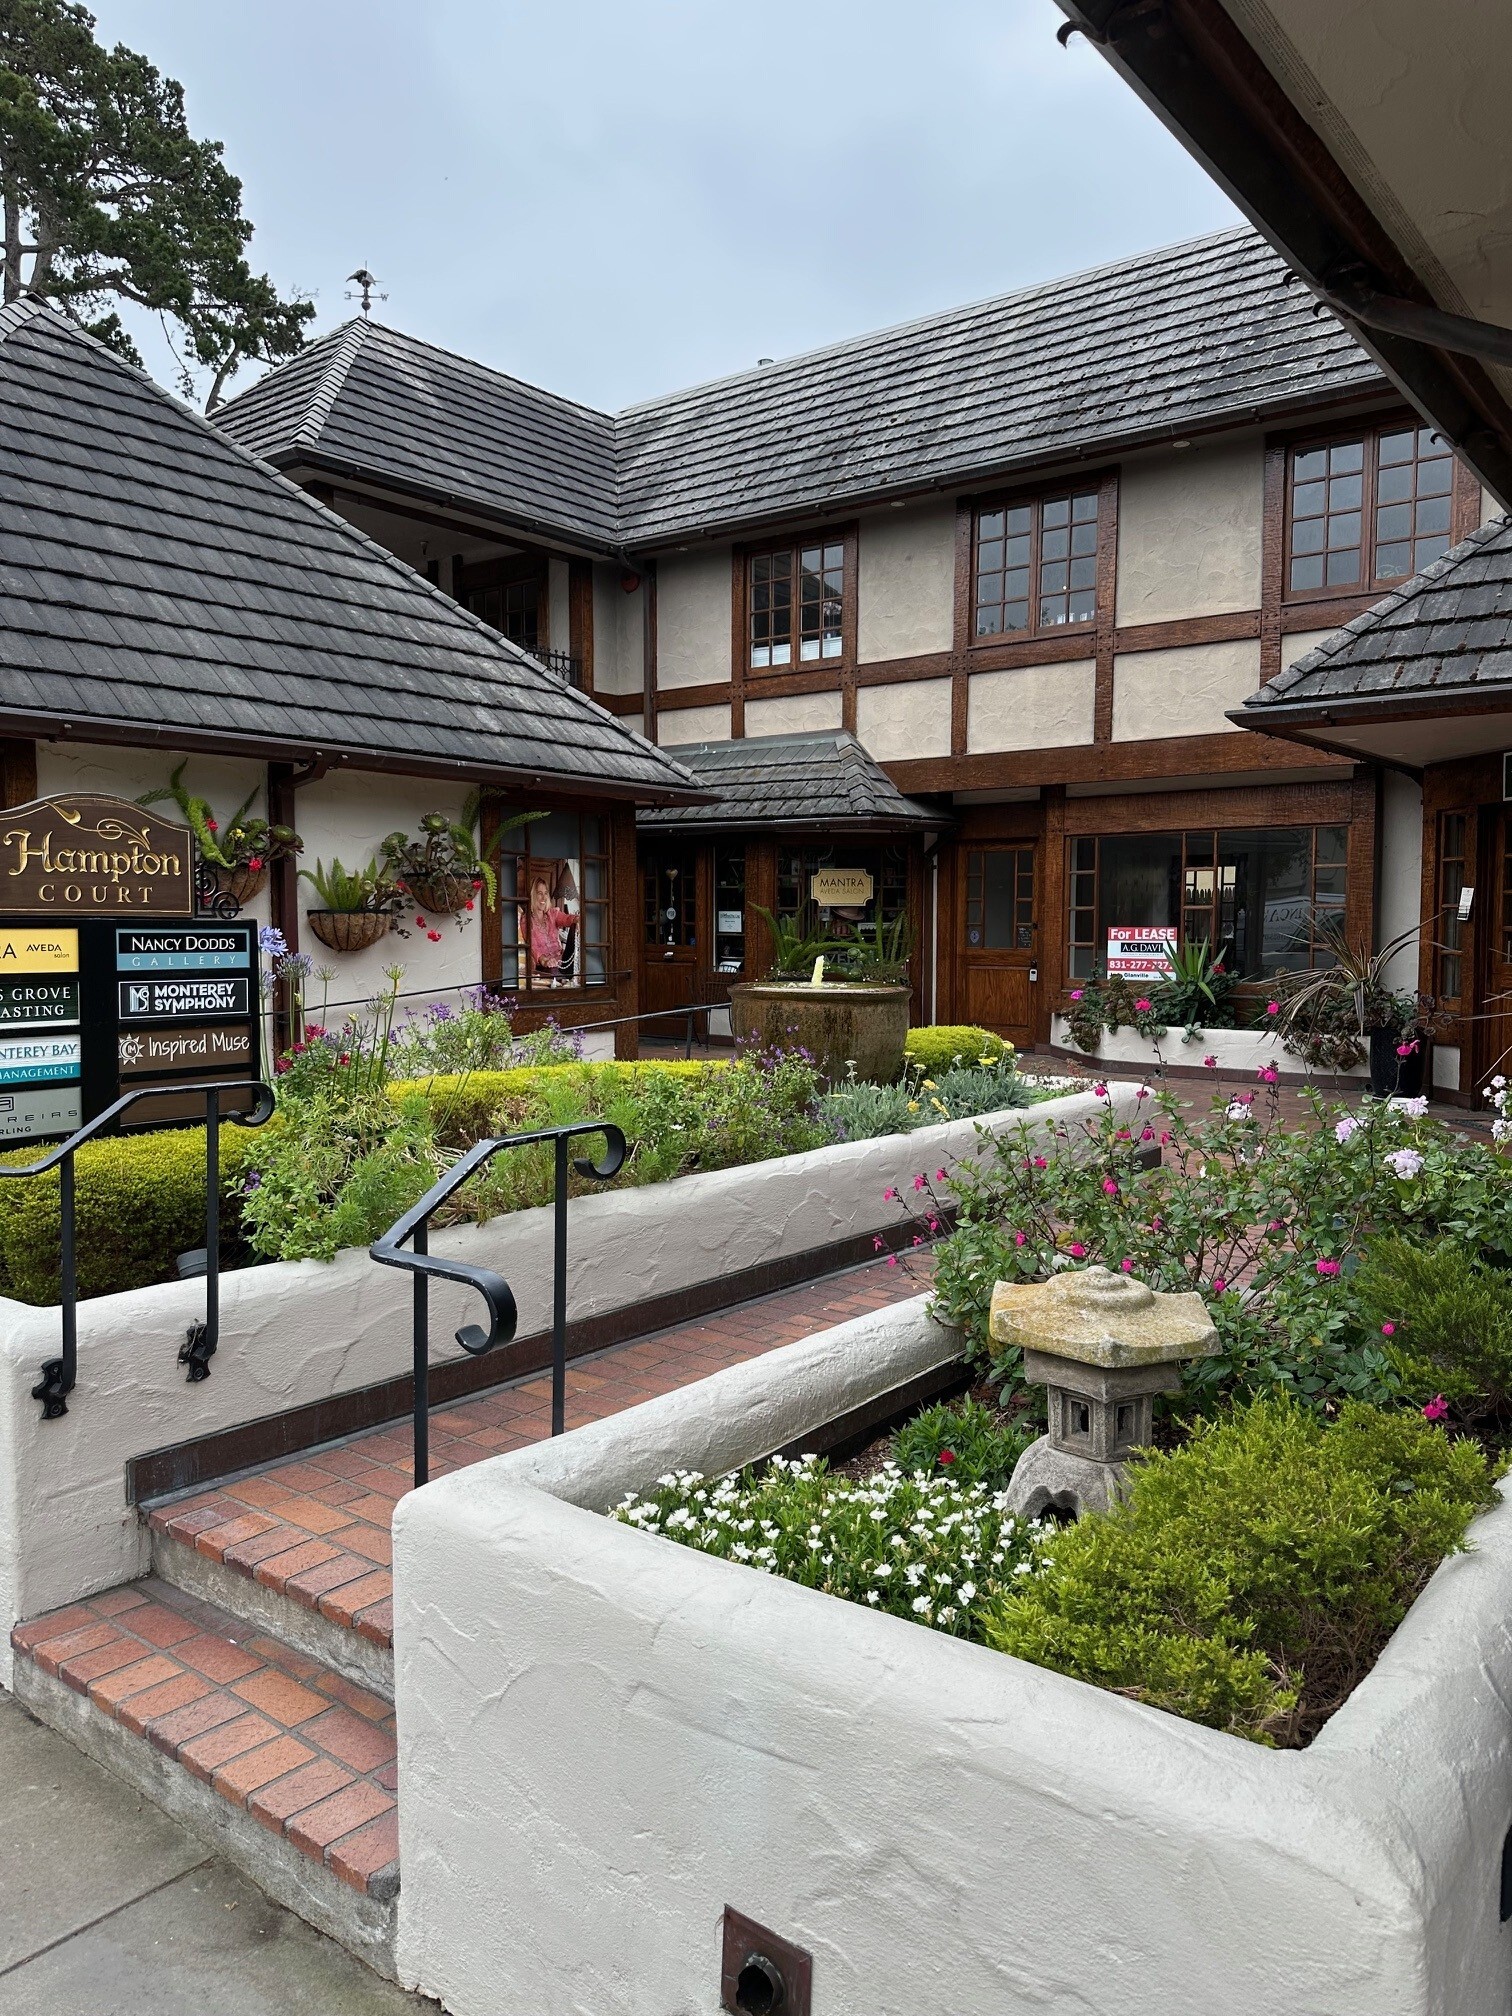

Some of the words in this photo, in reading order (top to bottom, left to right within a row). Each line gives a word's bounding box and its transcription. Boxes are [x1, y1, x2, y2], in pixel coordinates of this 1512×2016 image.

[3, 829, 181, 882] Hampton
[820, 878, 865, 887] MANTRA
[38, 884, 153, 903] COURT
[1110, 928, 1132, 940] For
[1134, 928, 1175, 940] LEASE
[0, 943, 17, 958] A
[26, 944, 62, 952] AVEDA
[131, 936, 182, 951] NANCY
[185, 936, 236, 950] DODDS
[132, 955, 236, 967] GALLERY
[12, 986, 71, 1001] GROVE
[154, 983, 235, 999] MONTEREY
[0, 1004, 65, 1019] ASTING
[154, 996, 236, 1013] SYMPHONY
[52, 1043, 78, 1056] BAY
[148, 1034, 208, 1061] Inspired
[211, 1032, 250, 1052] Muse
[0, 1065, 75, 1080] ANAGEMENT
